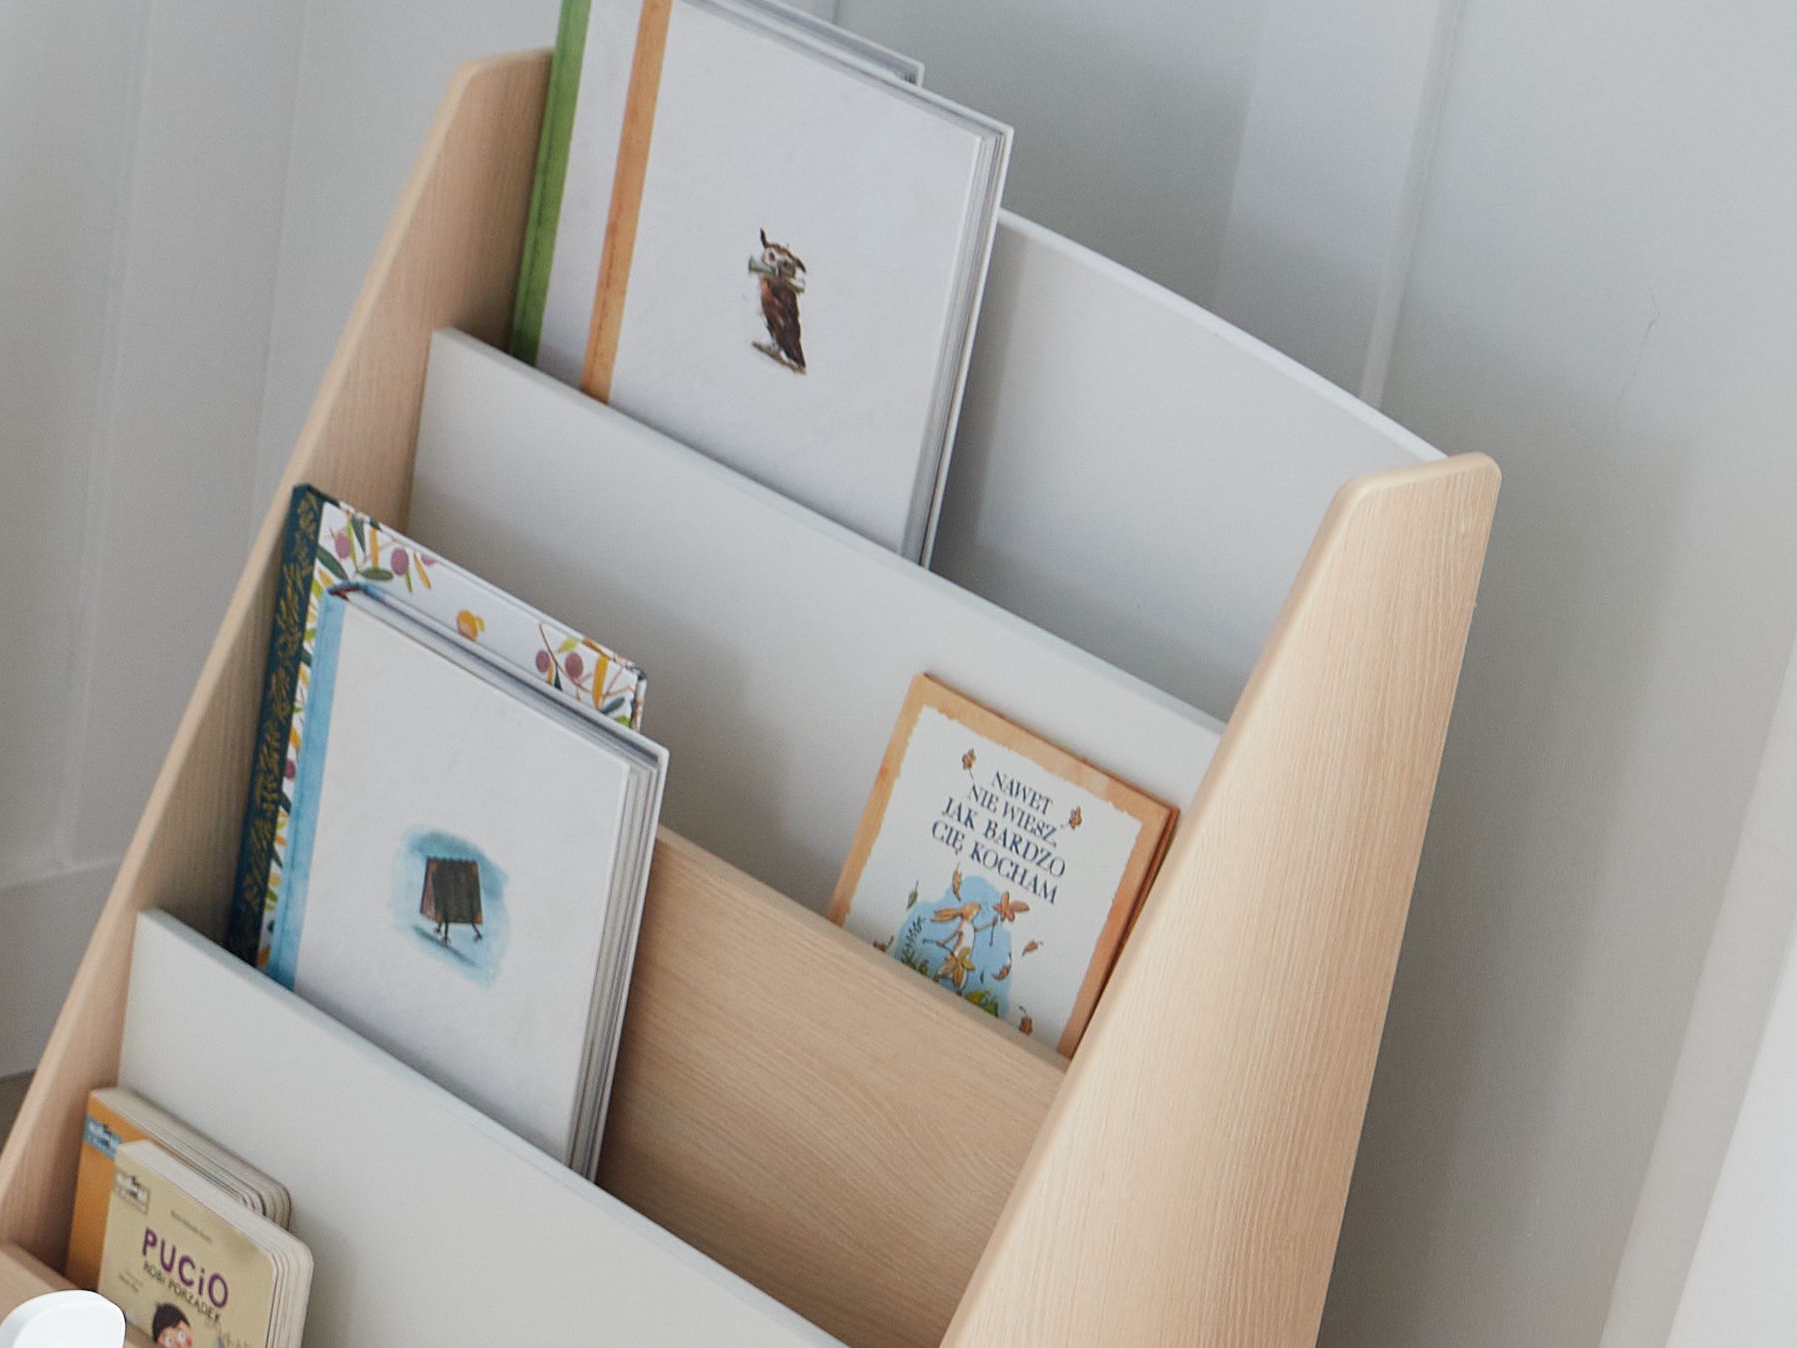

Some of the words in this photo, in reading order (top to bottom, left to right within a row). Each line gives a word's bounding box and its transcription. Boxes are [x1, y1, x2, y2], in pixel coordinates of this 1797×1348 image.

[969, 783, 998, 813] NIE
[1003, 801, 1057, 848] WIESZ,
[992, 770, 1053, 815] NAWET
[932, 820, 965, 855] CIĘ
[970, 841, 1057, 904] KOCHAM
[941, 797, 977, 830] JAK
[984, 819, 1065, 877] BARDZO
